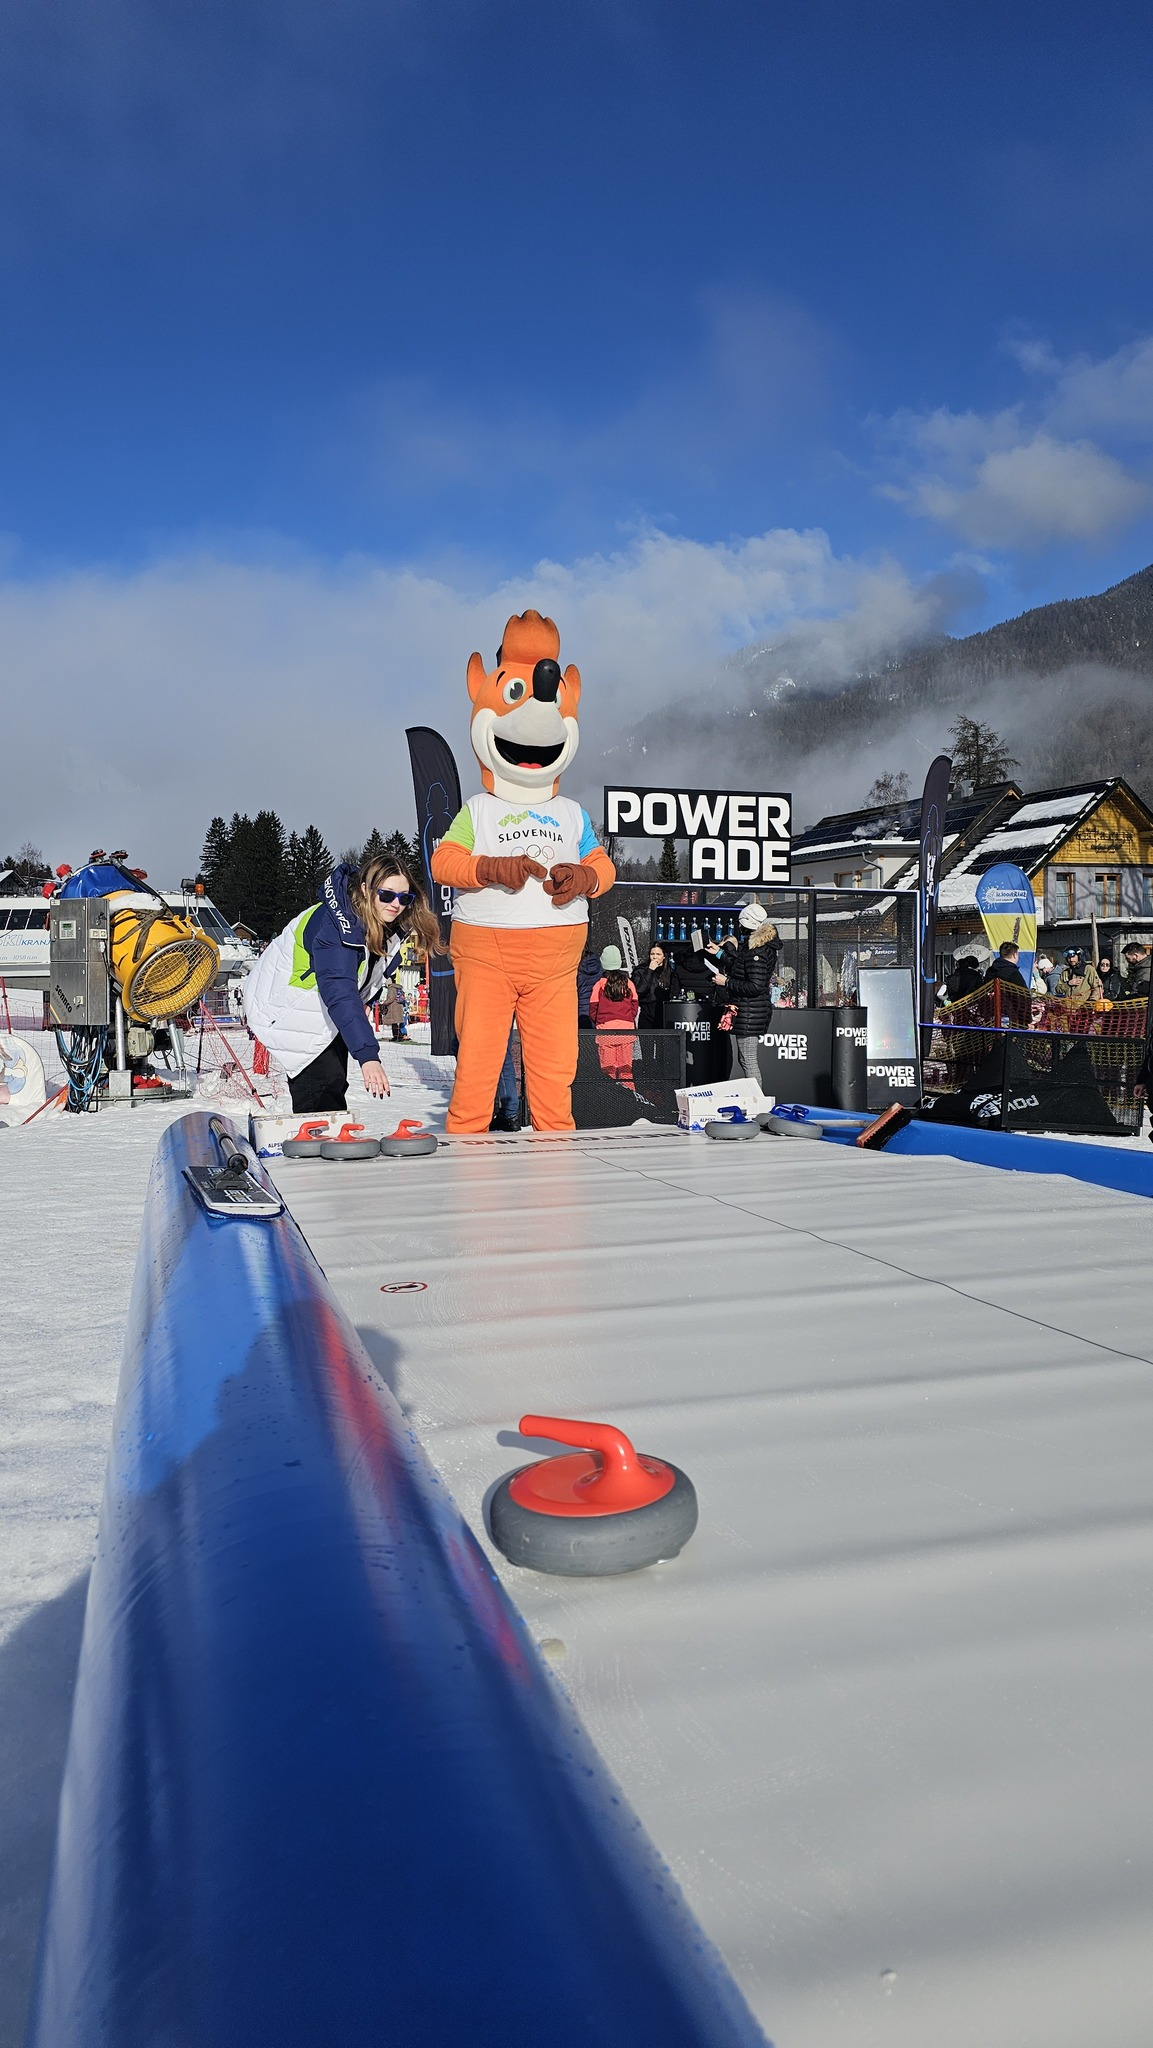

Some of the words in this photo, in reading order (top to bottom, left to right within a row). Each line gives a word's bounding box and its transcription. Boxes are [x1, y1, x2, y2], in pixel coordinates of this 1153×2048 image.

[607, 790, 791, 839] POWER
[498, 828, 564, 844] SLOVENIJA
[692, 838, 790, 882] ADE
[691, 1031, 711, 1042] ADE
[836, 1027, 867, 1037] POWE
[855, 1037, 868, 1047] AD
[777, 1046, 808, 1060] ADE
[867, 1066, 915, 1077] POWER
[888, 1076, 916, 1087] ADE
